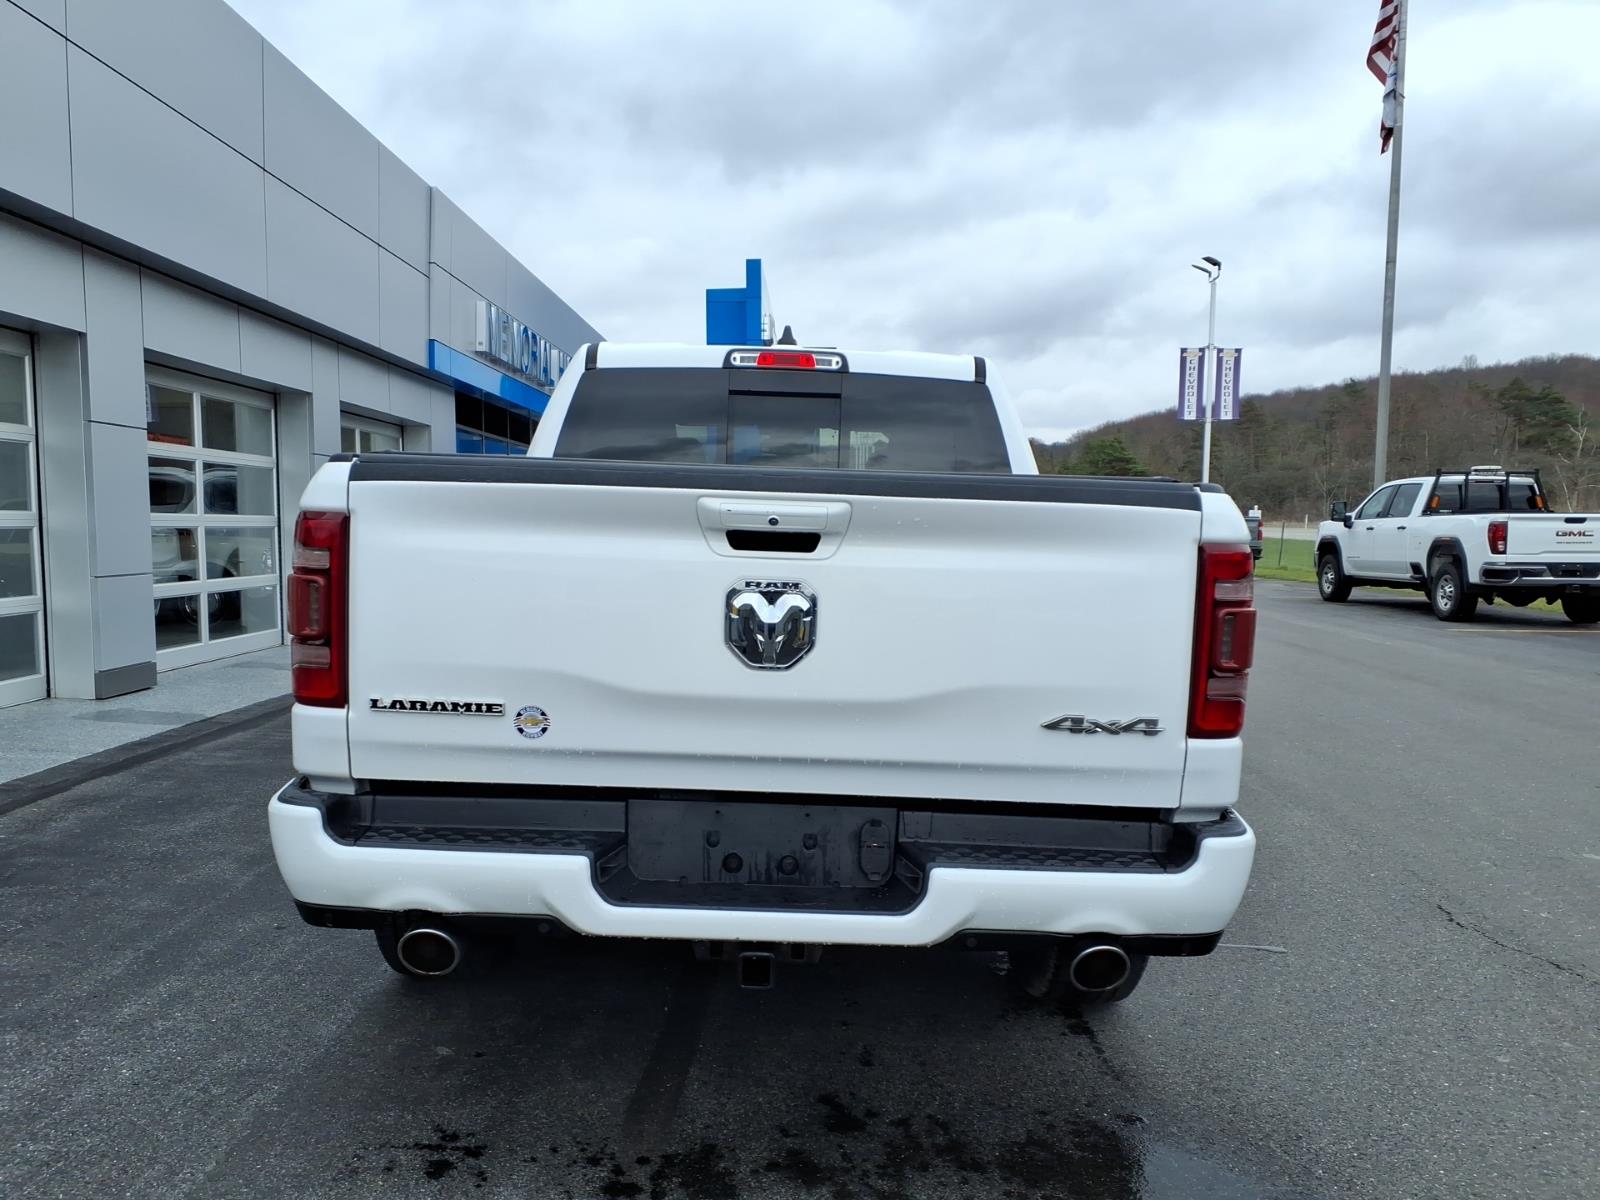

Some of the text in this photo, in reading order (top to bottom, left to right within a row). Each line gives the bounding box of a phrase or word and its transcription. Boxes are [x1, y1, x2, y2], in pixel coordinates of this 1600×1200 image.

[1186, 358, 1197, 416] CHEVROLET
[1223, 359, 1232, 417] CHEVROLET
[1555, 529, 1595, 537] GMC
[744, 580, 801, 590] RAM
[369, 697, 504, 715] LARAMIE
